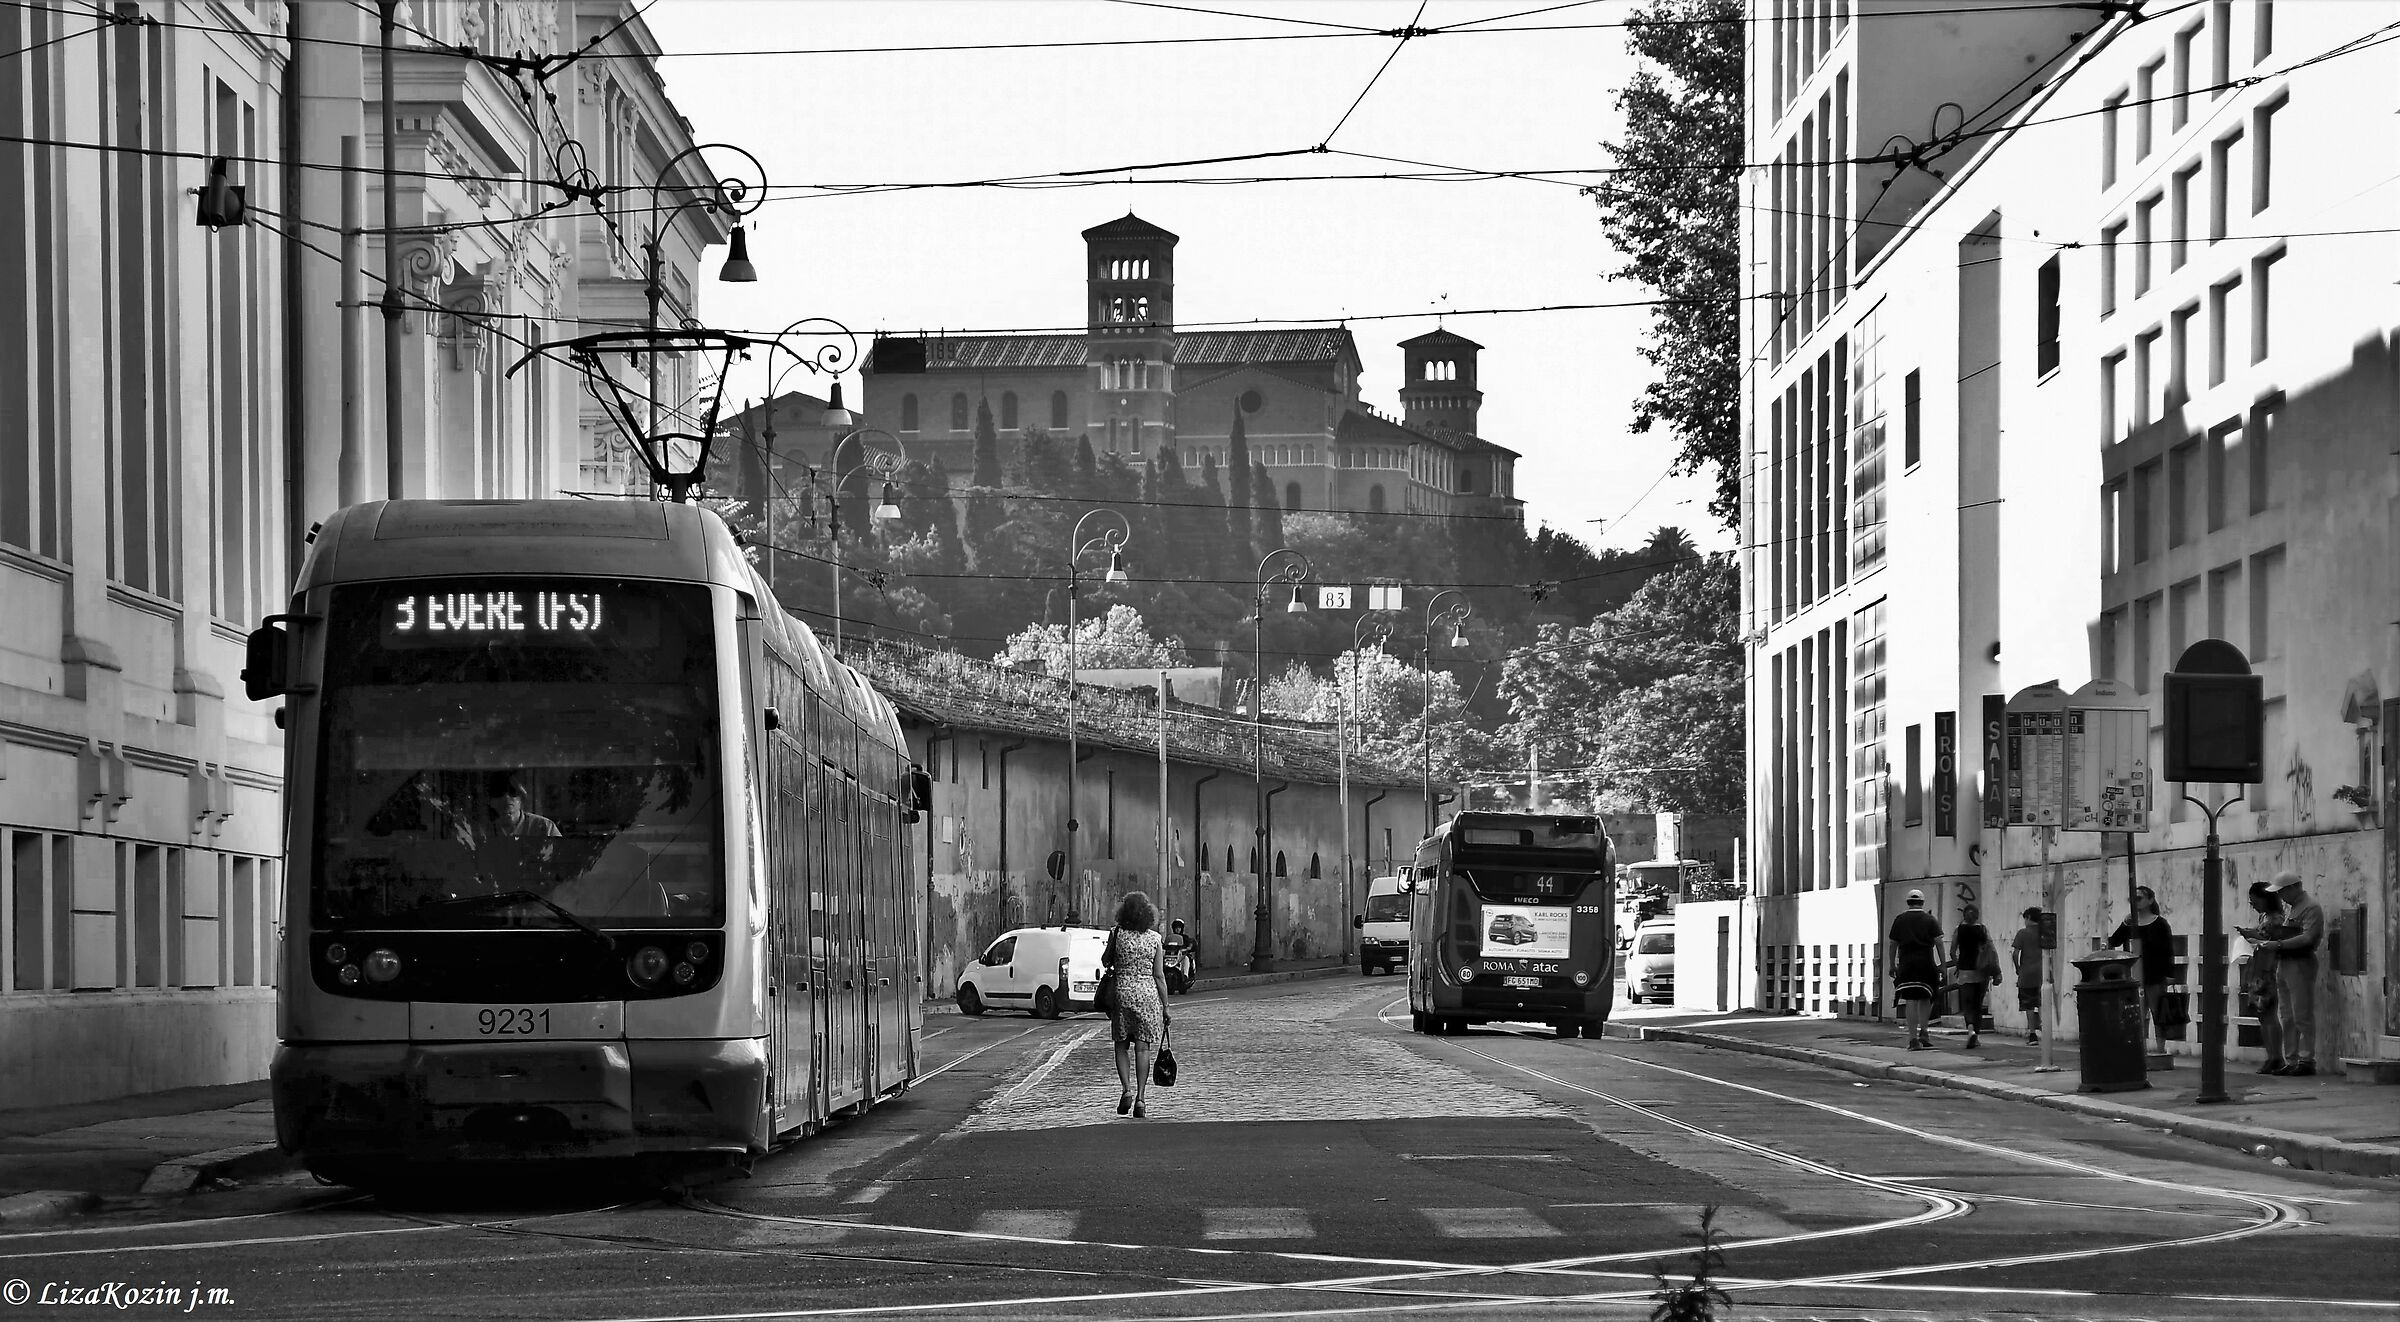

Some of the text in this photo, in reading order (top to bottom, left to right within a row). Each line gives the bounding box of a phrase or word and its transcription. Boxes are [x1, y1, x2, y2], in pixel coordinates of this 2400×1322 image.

[1325, 592, 1345, 608] 83
[396, 595, 415, 630] 3
[1989, 720, 2001, 802] SALA
[1940, 716, 1952, 832] TROISI
[1536, 876, 1553, 893] 44
[1576, 905, 1599, 913] 3358
[1462, 970, 1471, 978] 80
[1483, 961, 1559, 973] ROMA atac
[478, 1008, 550, 1034] 9231
